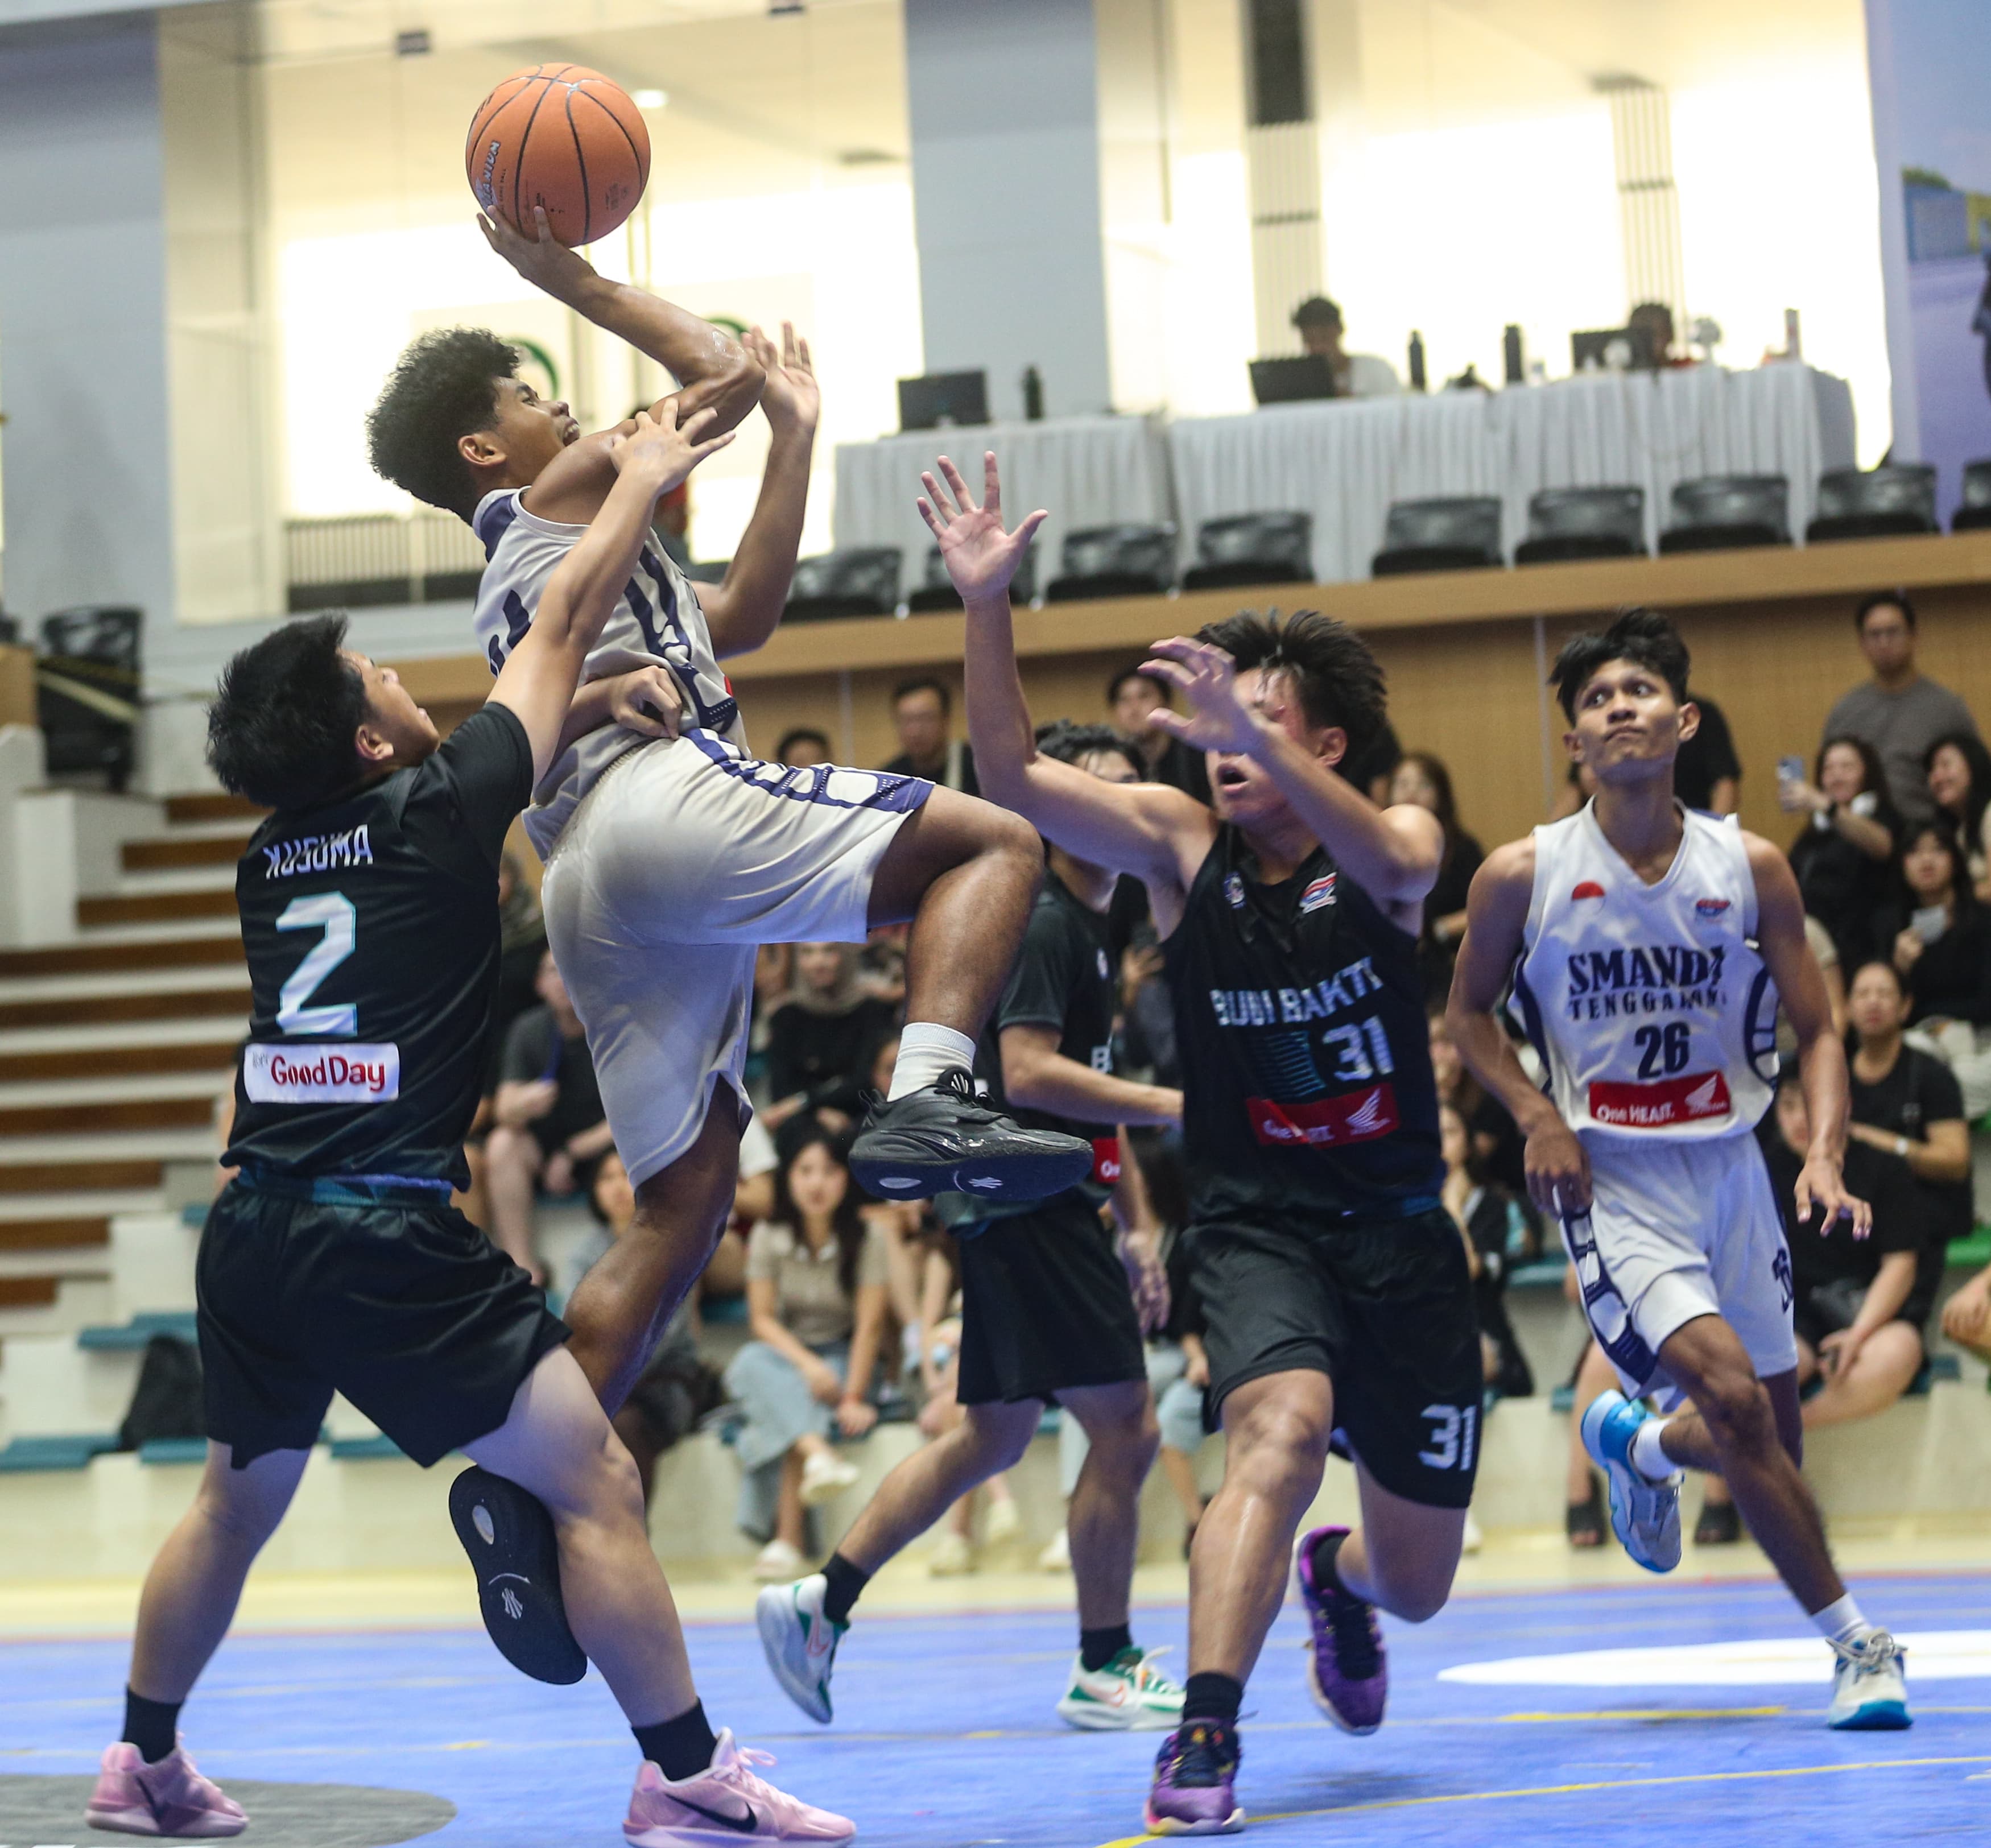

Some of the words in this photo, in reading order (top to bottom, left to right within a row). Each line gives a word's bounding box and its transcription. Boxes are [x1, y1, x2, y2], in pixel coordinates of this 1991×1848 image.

[263, 824, 373, 879] KUSUMA
[276, 890, 357, 1037] 2
[1321, 1014, 1394, 1081] 31
[1634, 1022, 1690, 1080] 26
[1418, 1403, 1477, 1471] 31
